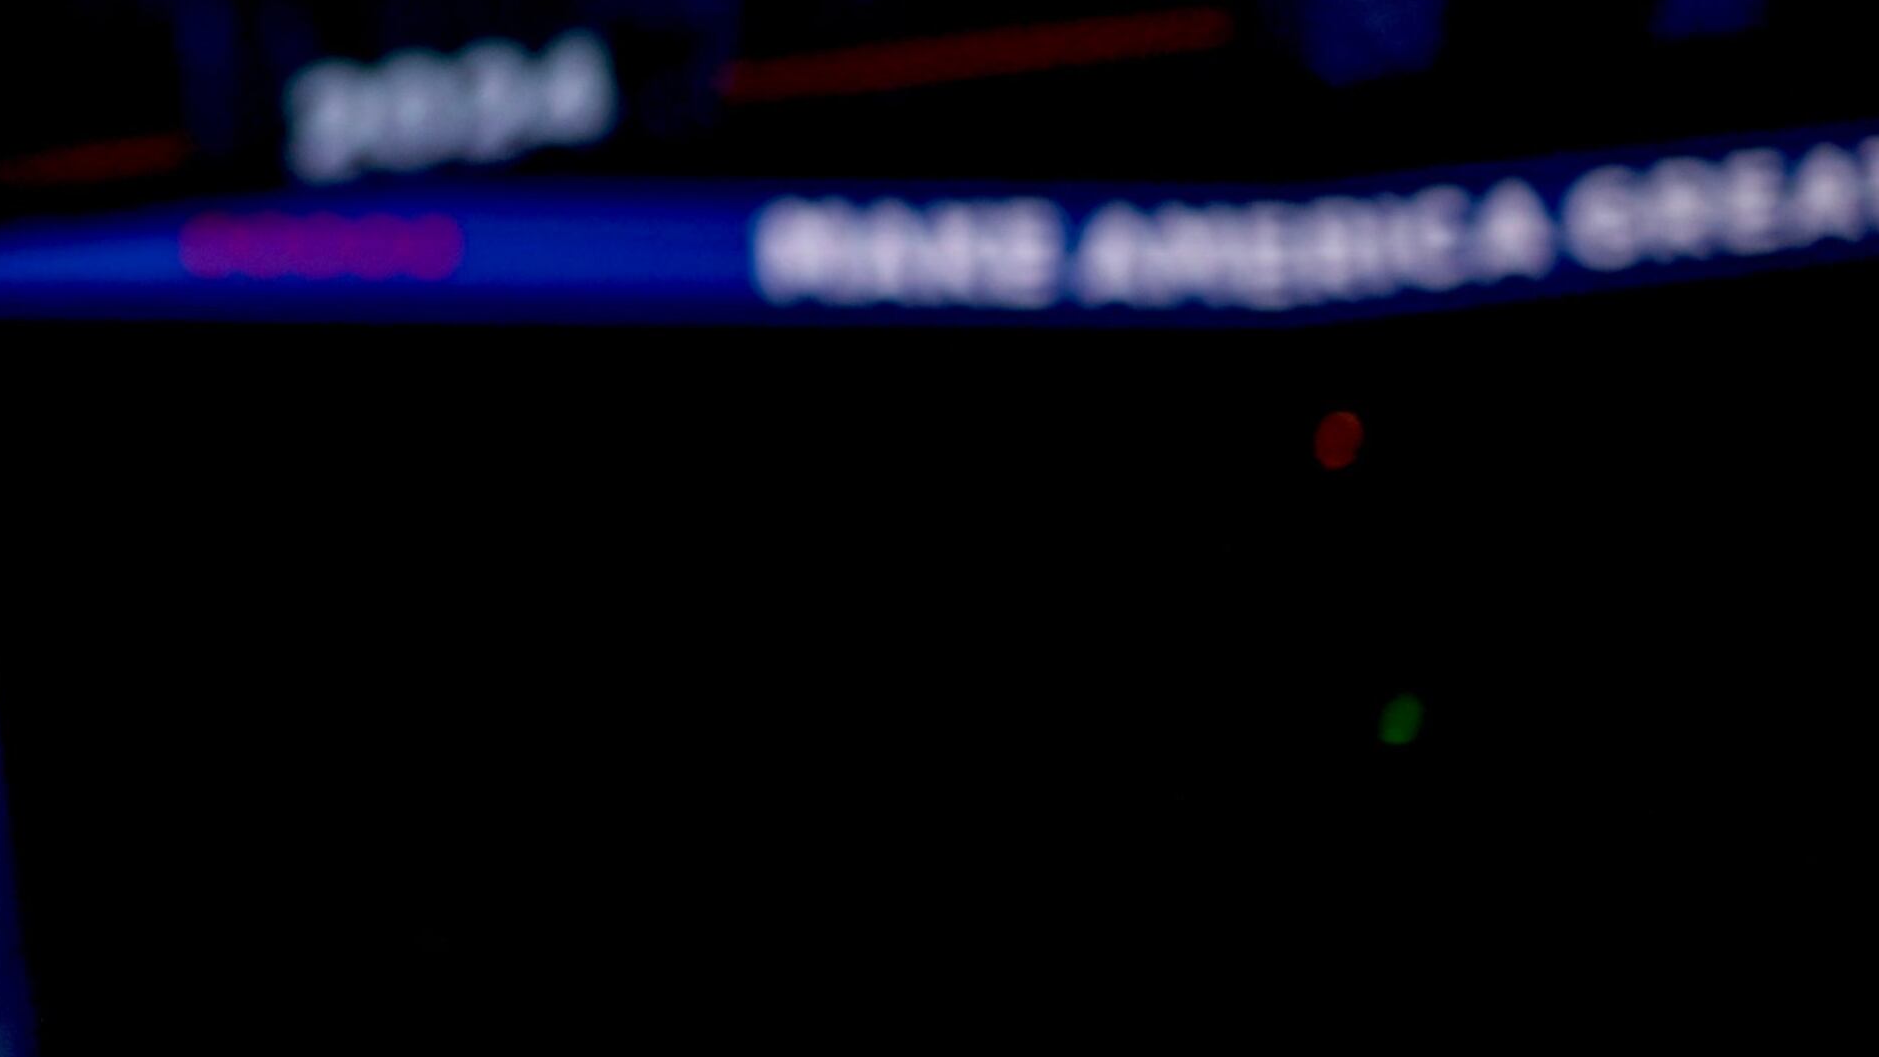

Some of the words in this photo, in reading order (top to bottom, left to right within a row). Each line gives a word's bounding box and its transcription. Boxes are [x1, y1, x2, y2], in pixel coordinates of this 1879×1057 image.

[293, 36, 611, 180] 2024
[751, 198, 1069, 308] MAKE
[1069, 180, 1557, 309] AMERICA
[1559, 136, 1879, 270] GREA
